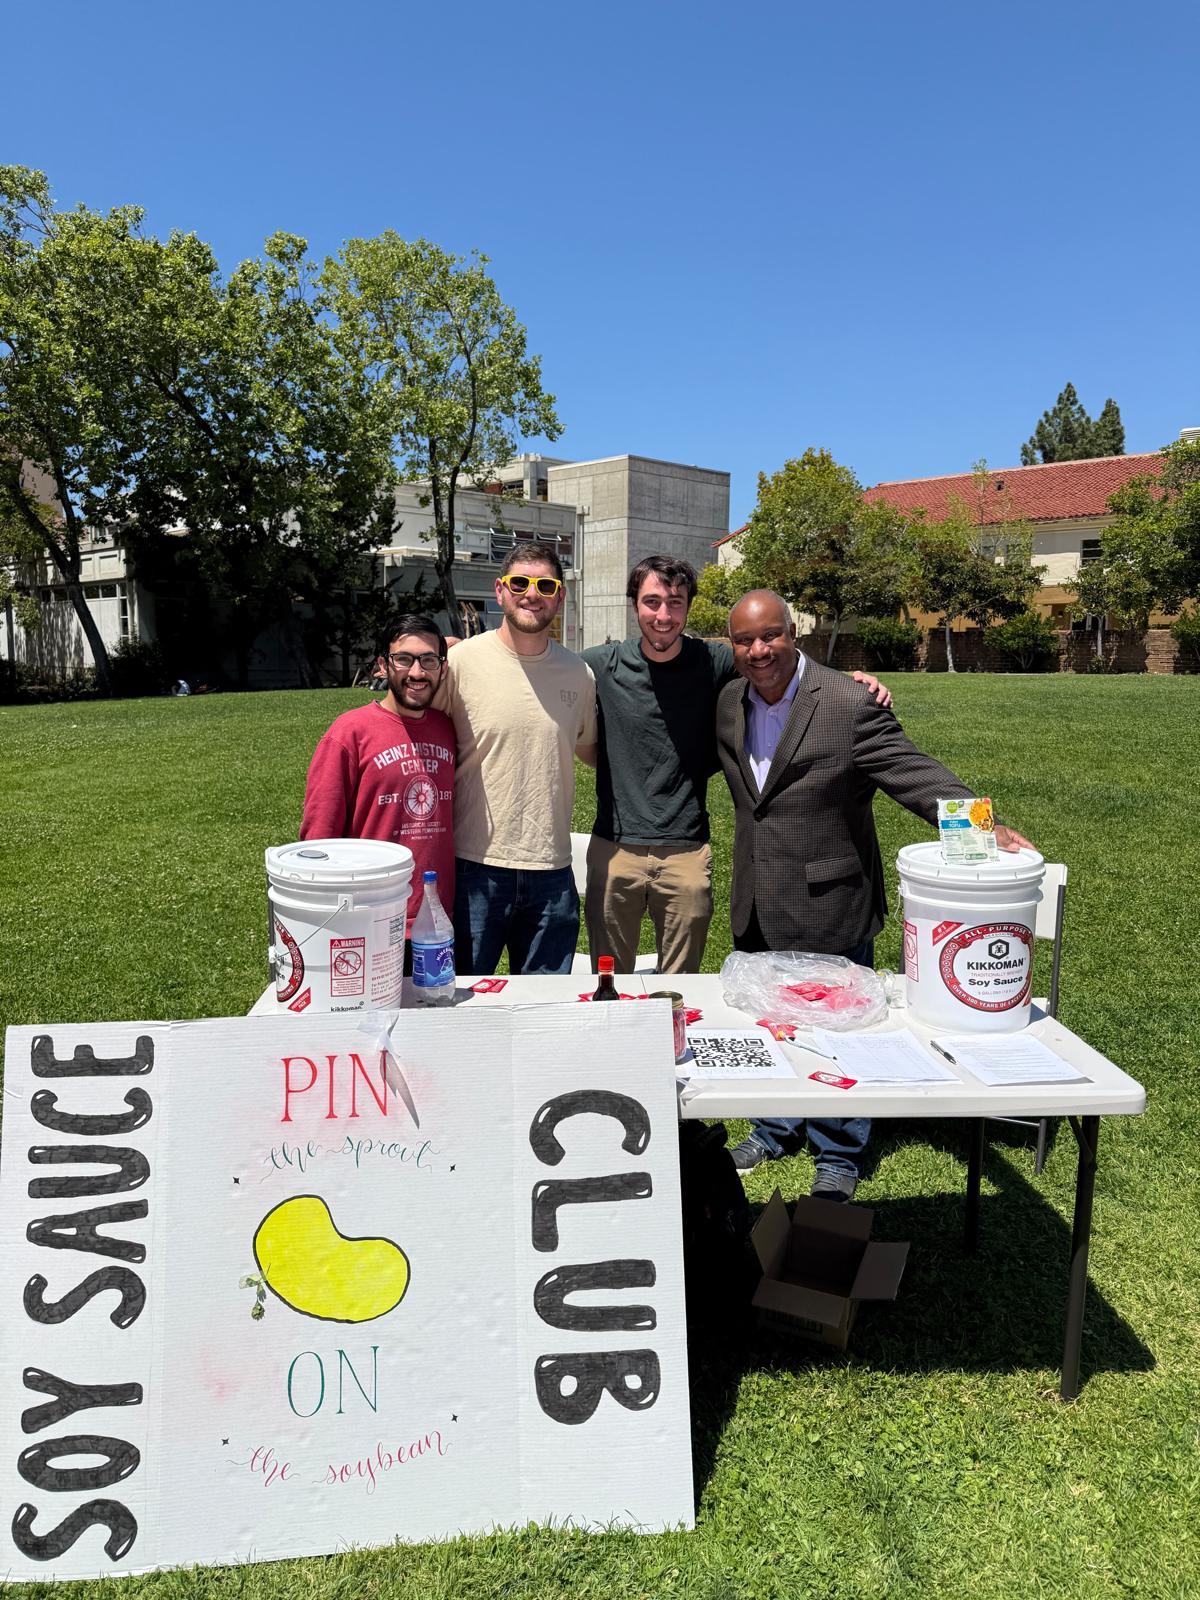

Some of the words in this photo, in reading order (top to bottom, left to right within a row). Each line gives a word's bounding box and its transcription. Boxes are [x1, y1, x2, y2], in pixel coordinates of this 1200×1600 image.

[373, 743, 410, 769] HEINZ
[411, 742, 453, 765] HISTORY
[400, 759, 438, 775] CENTER
[378, 793, 401, 805] EST.
[967, 958, 1024, 970] KIKKOMAN
[968, 978, 990, 987] Soy
[994, 976, 1023, 985] Sauce
[952, 984, 966, 998] OVER
[967, 996, 978, 1005] 300
[281, 1049, 389, 1122] PIN
[23, 1034, 155, 1330] SAUCE
[261, 1139, 321, 1182] the
[328, 1135, 440, 1173] sprout
[529, 1089, 661, 1426] CLUB
[287, 1345, 379, 1417] ON
[12, 1366, 143, 1562] SOY
[226, 1446, 300, 1488] the
[312, 1430, 454, 1495] soybean
